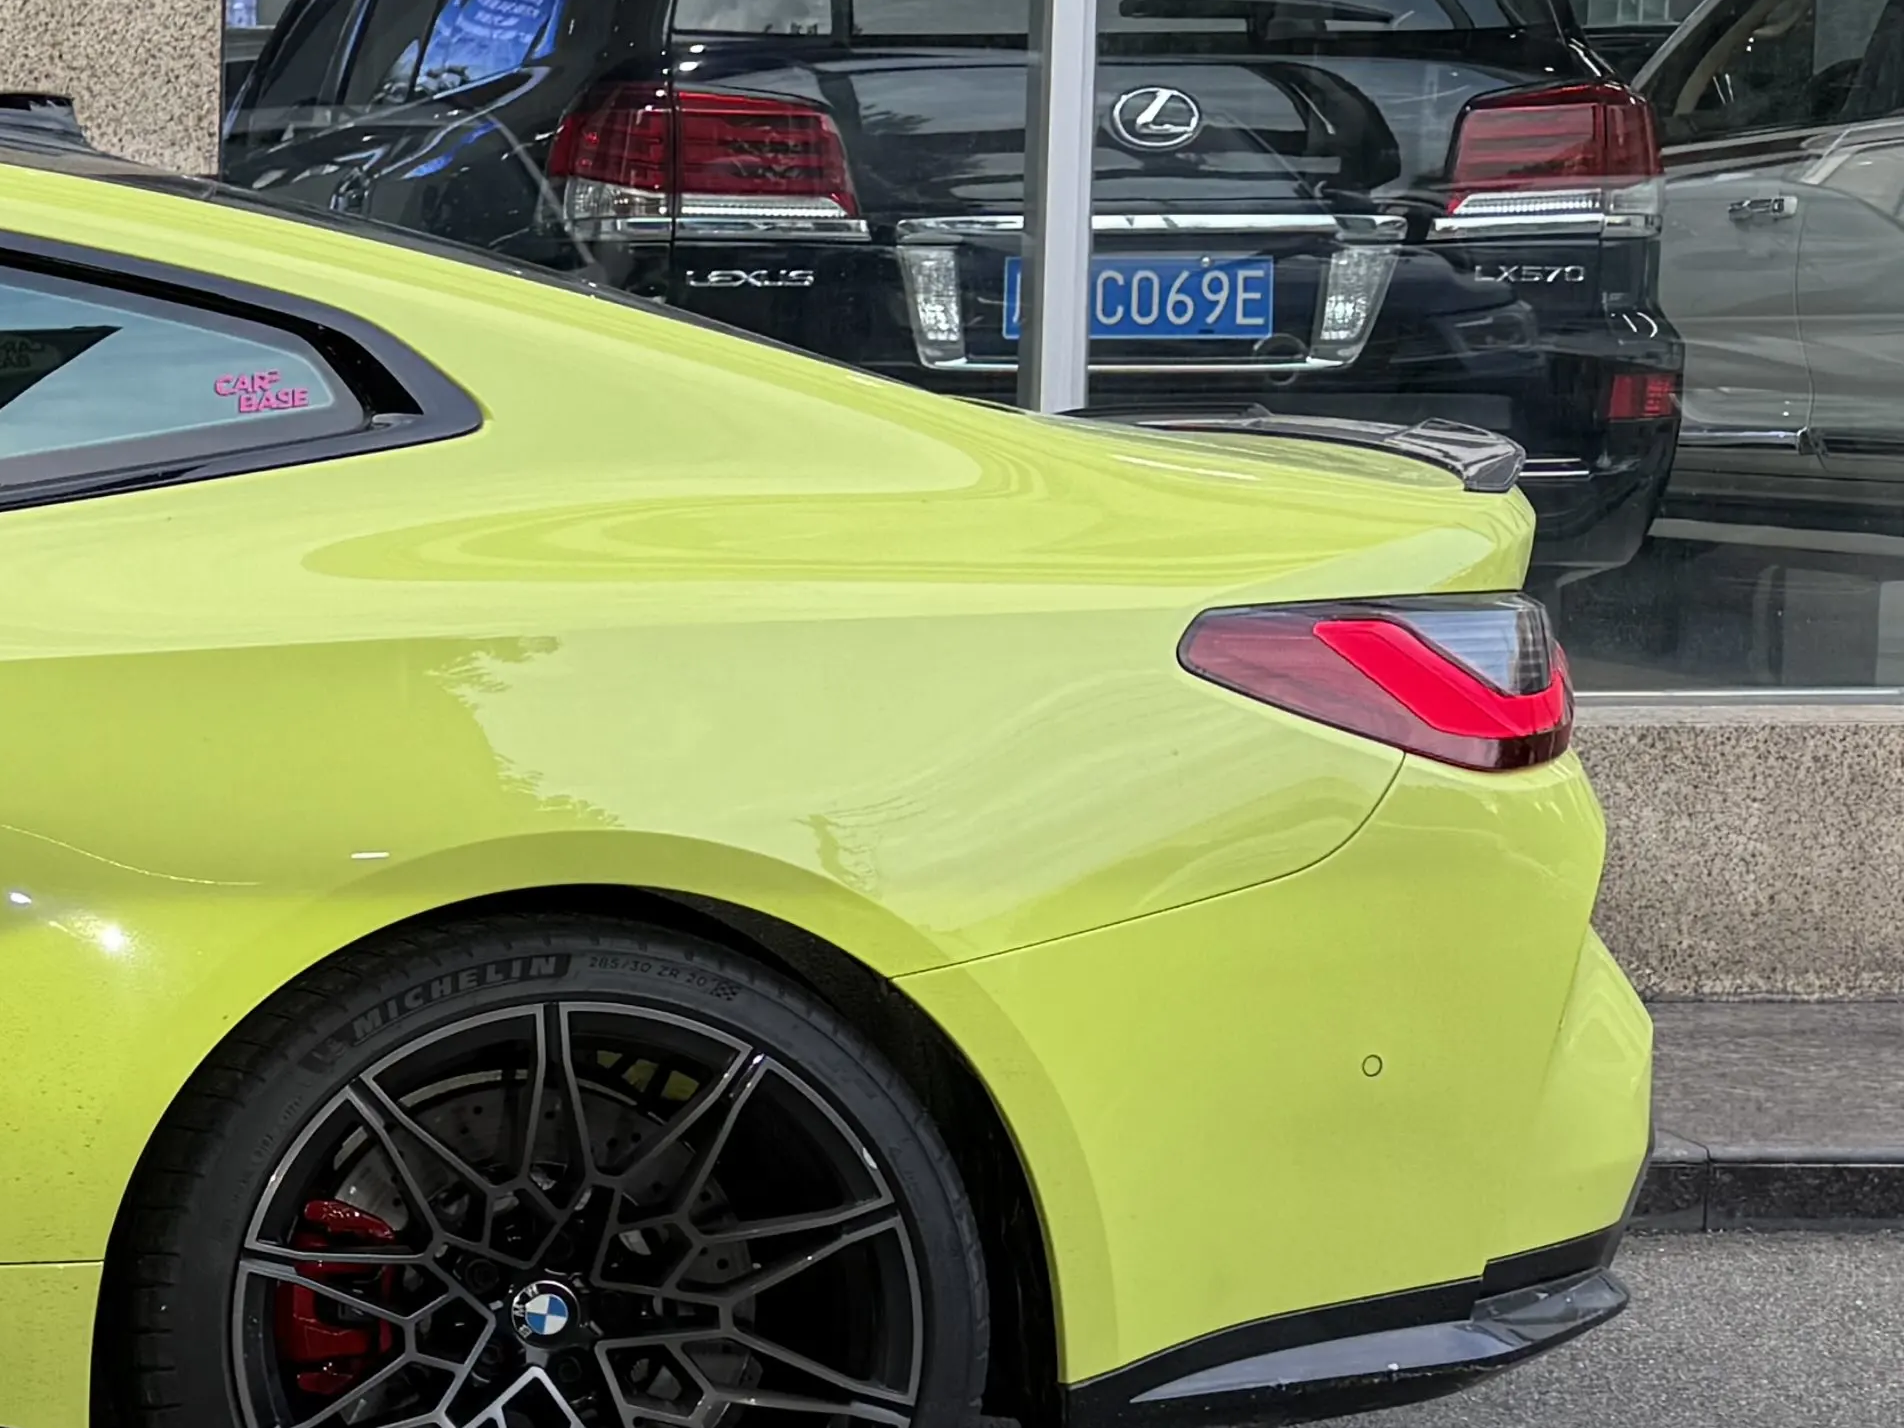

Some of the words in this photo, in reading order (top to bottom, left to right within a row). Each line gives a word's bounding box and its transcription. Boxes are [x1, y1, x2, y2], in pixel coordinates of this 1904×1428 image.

[685, 269, 815, 288] LEXUS
[1474, 265, 1585, 283] LX570
[352, 955, 557, 1038] MICHELIN
